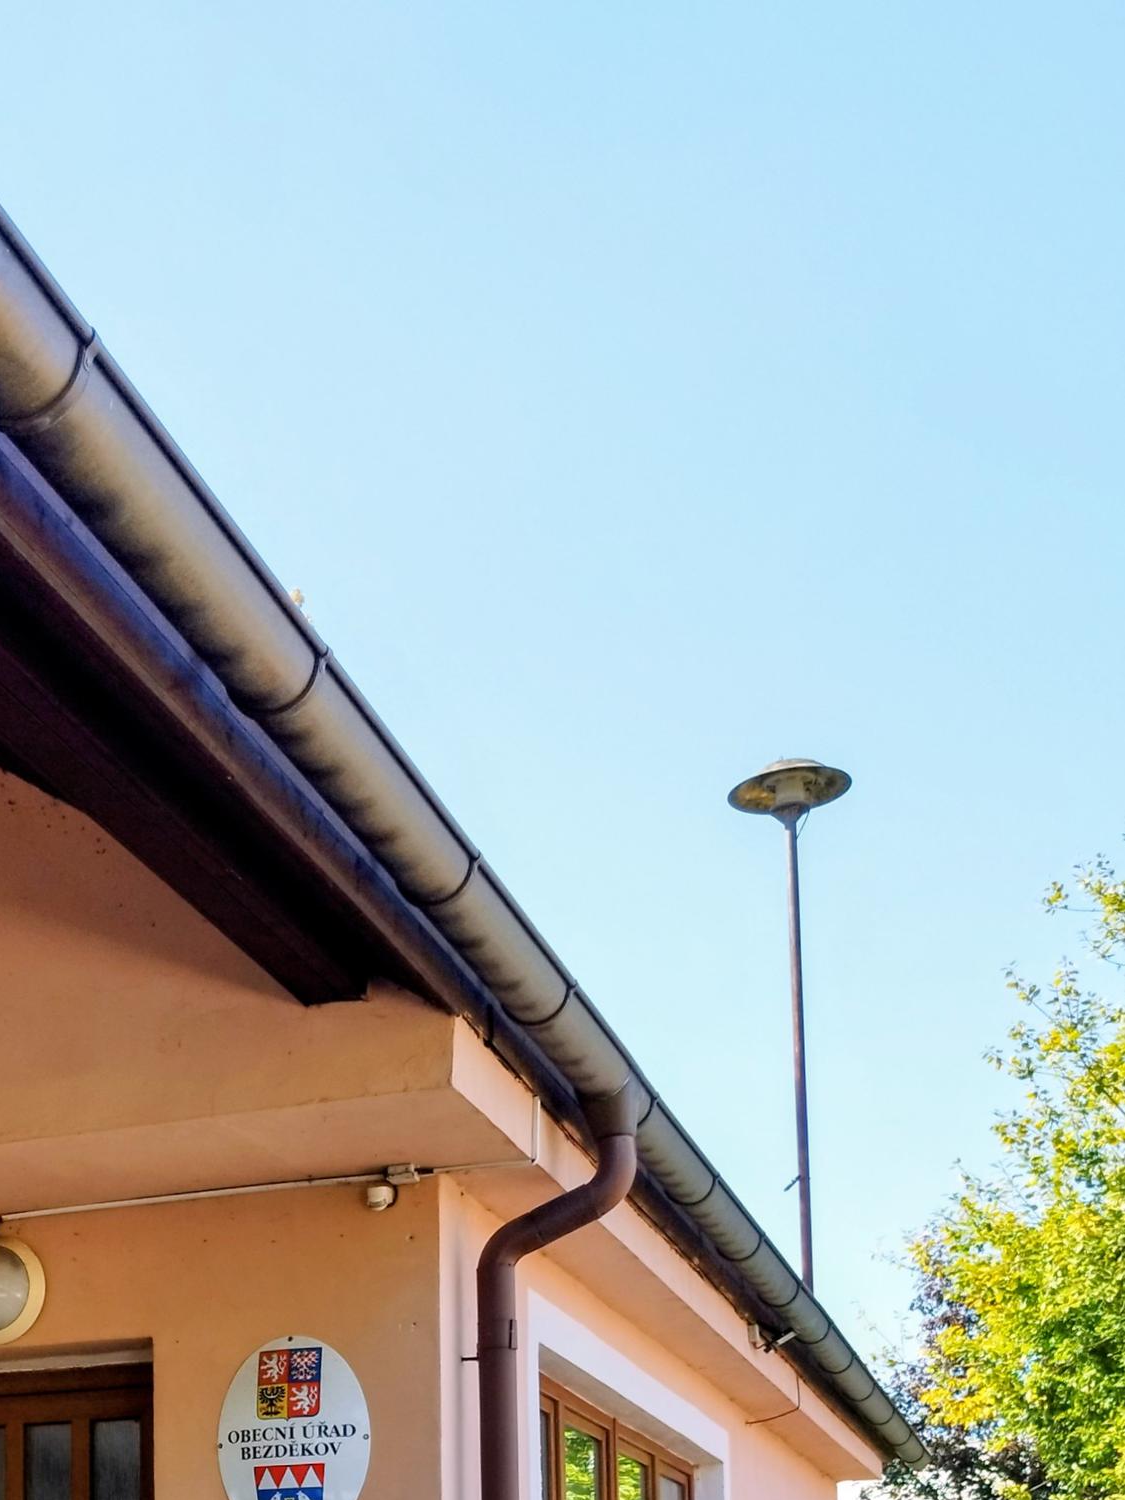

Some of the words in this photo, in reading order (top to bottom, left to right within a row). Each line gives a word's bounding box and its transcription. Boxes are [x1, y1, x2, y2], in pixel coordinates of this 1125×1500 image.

[228, 1423, 295, 1444] OBECNÍ
[302, 1421, 356, 1439] ÚŘAD
[241, 1441, 342, 1460] BEZDĚKOV
